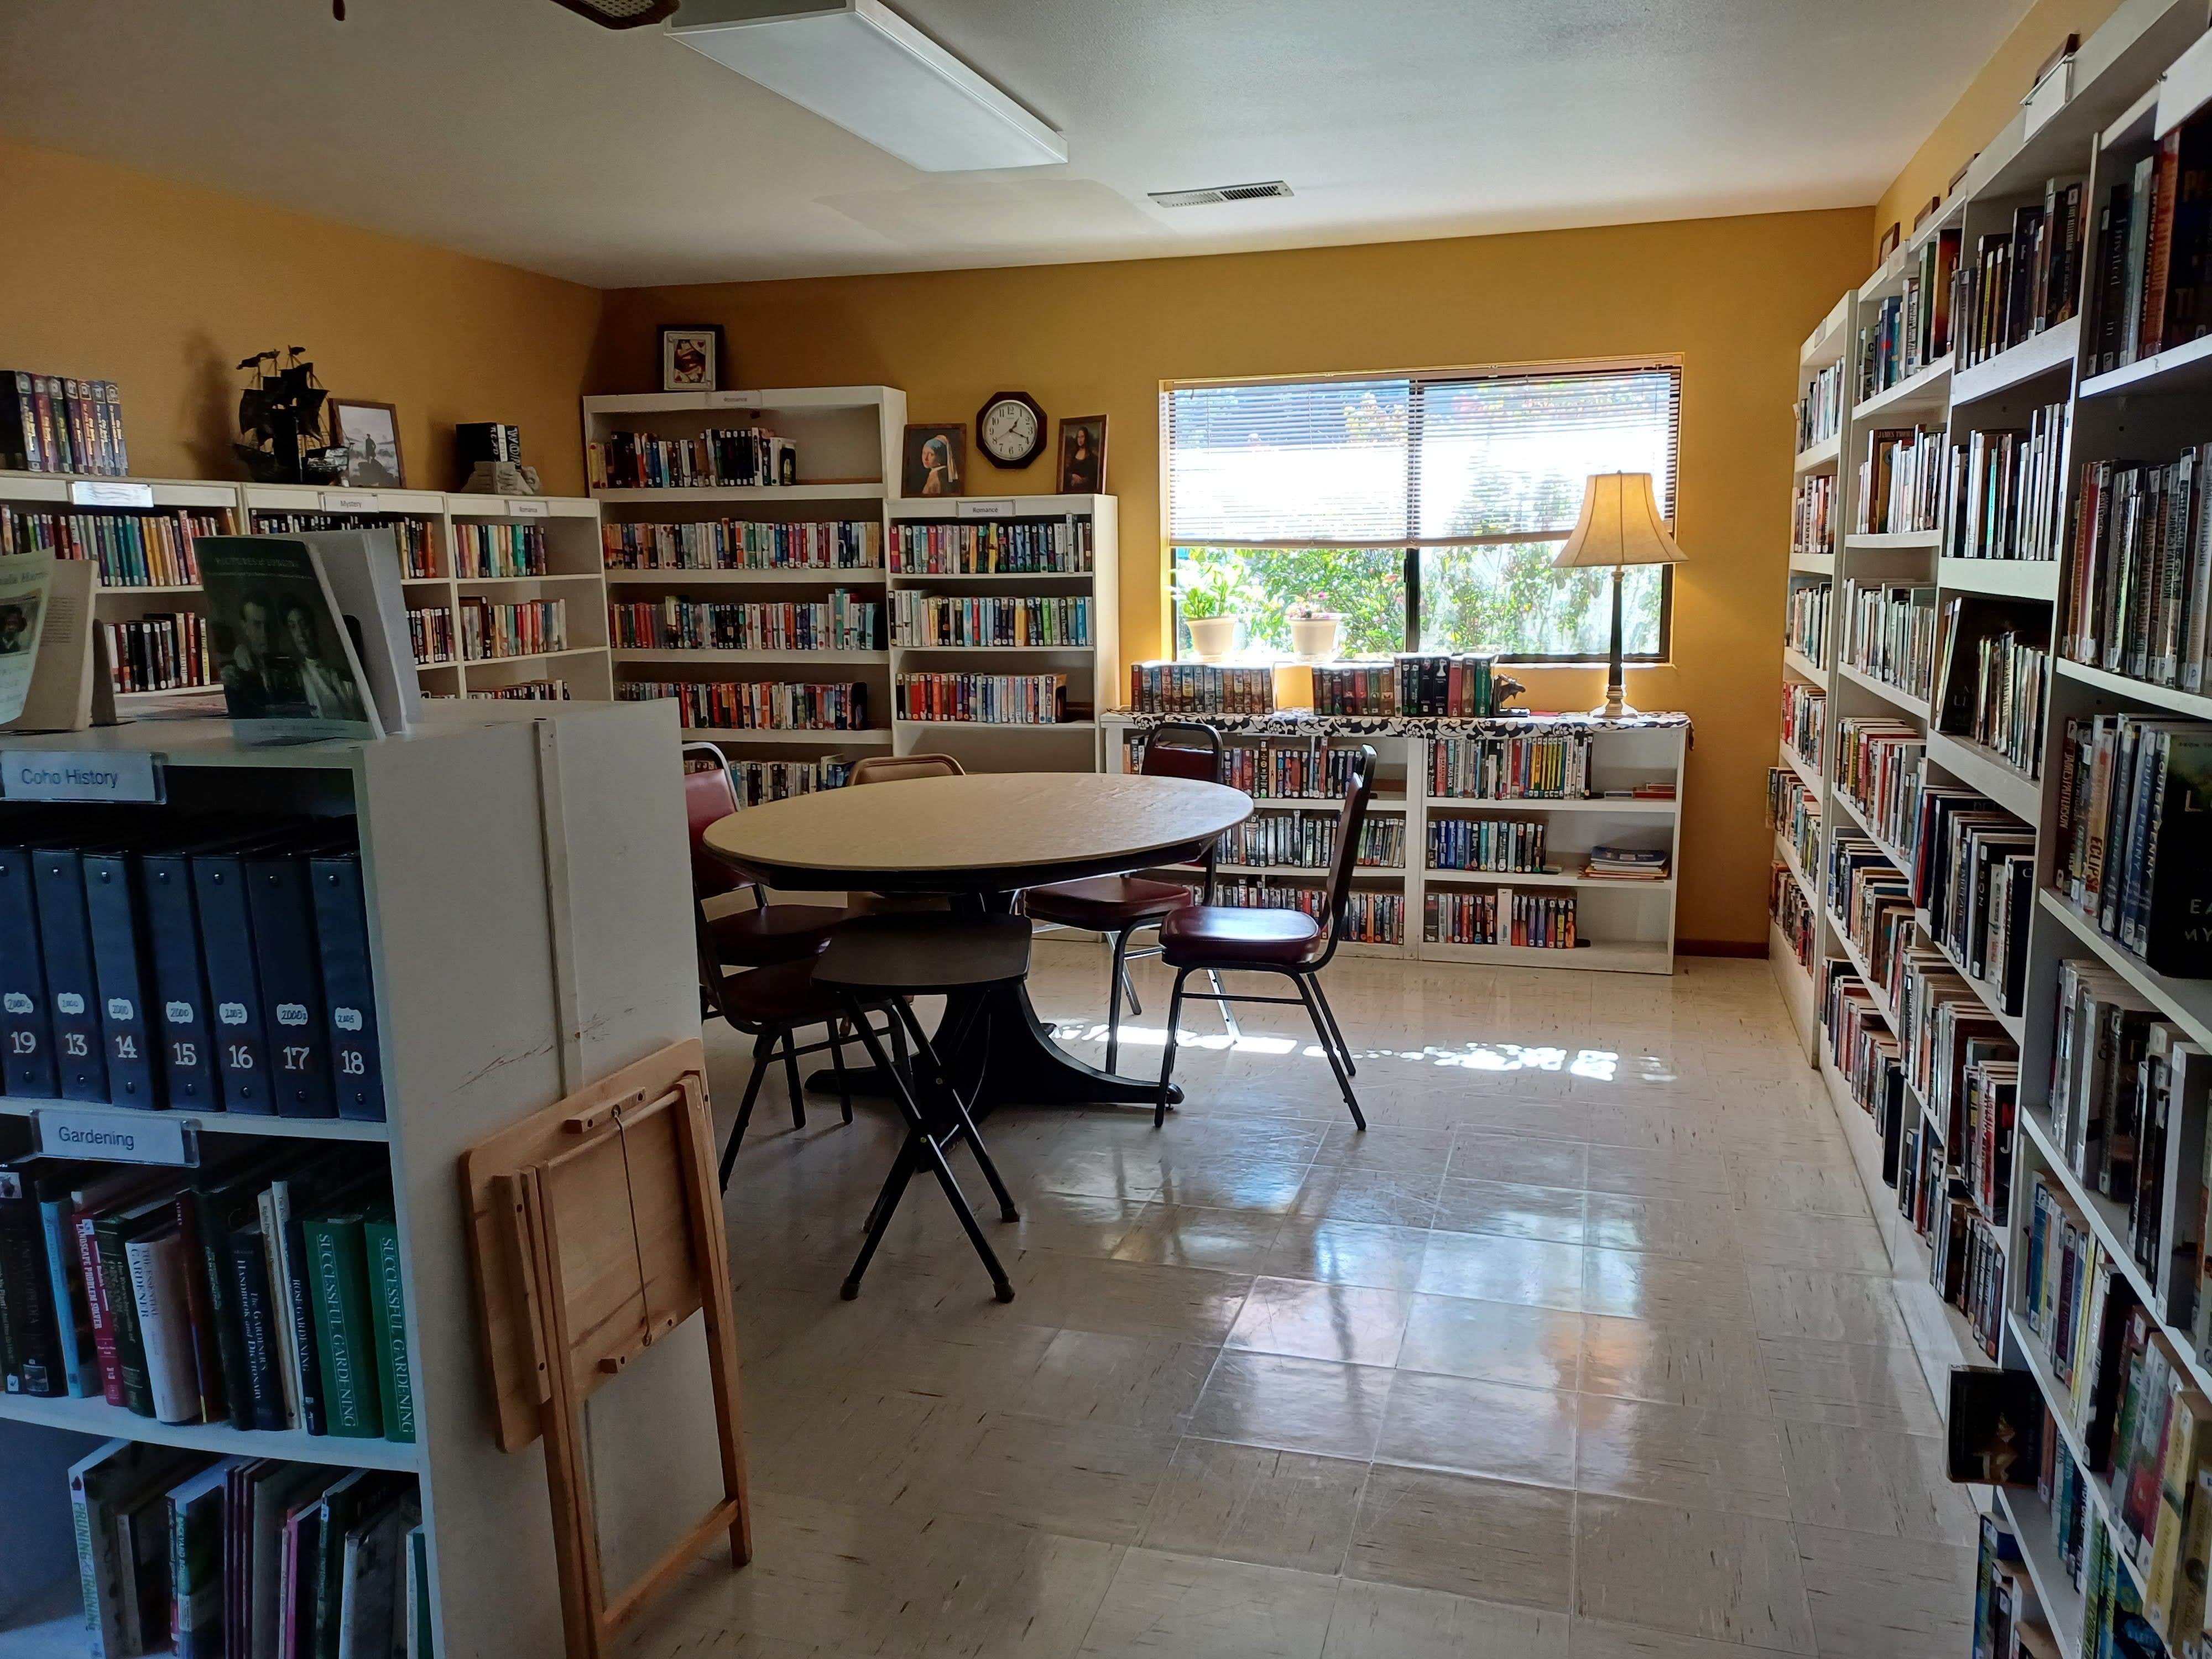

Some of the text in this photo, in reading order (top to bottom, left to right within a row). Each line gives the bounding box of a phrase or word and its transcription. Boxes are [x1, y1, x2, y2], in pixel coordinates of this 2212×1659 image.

[992, 417, 999, 425] 10
[999, 409, 1004, 418] 11
[1008, 406, 1014, 415] 12
[1020, 409, 1022, 417] 1
[1025, 416, 1030, 425] 2
[999, 443, 1003, 452] 7
[340, 499, 362, 508] Mystery
[2136, 515, 2156, 634] JAMES PATTERSON
[2163, 547, 2176, 599] PATTERSON
[21, 768, 119, 789] Coho History
[2132, 755, 2153, 871] OUISE PENNY
[2145, 820, 2161, 879] PENNY
[11, 1031, 36, 1055] 19
[65, 1032, 87, 1057] 13
[115, 1035, 138, 1058] 14
[173, 1043, 197, 1066] 15
[229, 1045, 253, 1069] 16
[283, 1046, 309, 1071] 17
[341, 1050, 364, 1075] 18
[58, 1125, 135, 1150] Gardening
[75, 1223, 93, 1266] LANDSCAPE
[83, 1266, 97, 1302] PROBLEM
[130, 1249, 149, 1318] GARDENER
[90, 1302, 102, 1329] SOLVER
[292, 1279, 310, 1372] ROSE GARDENING
[236, 1260, 262, 1400] HANDBOOK and DICTIONARY
[250, 1292, 267, 1371] The GARDENER'S
[318, 1234, 356, 1427] SUCCESSFUL GARDENING
[382, 1237, 414, 1433] SUCCESSFUL GARDENING
[72, 1502, 90, 1559] PRUNING
[83, 1572, 102, 1631] TRAINING
